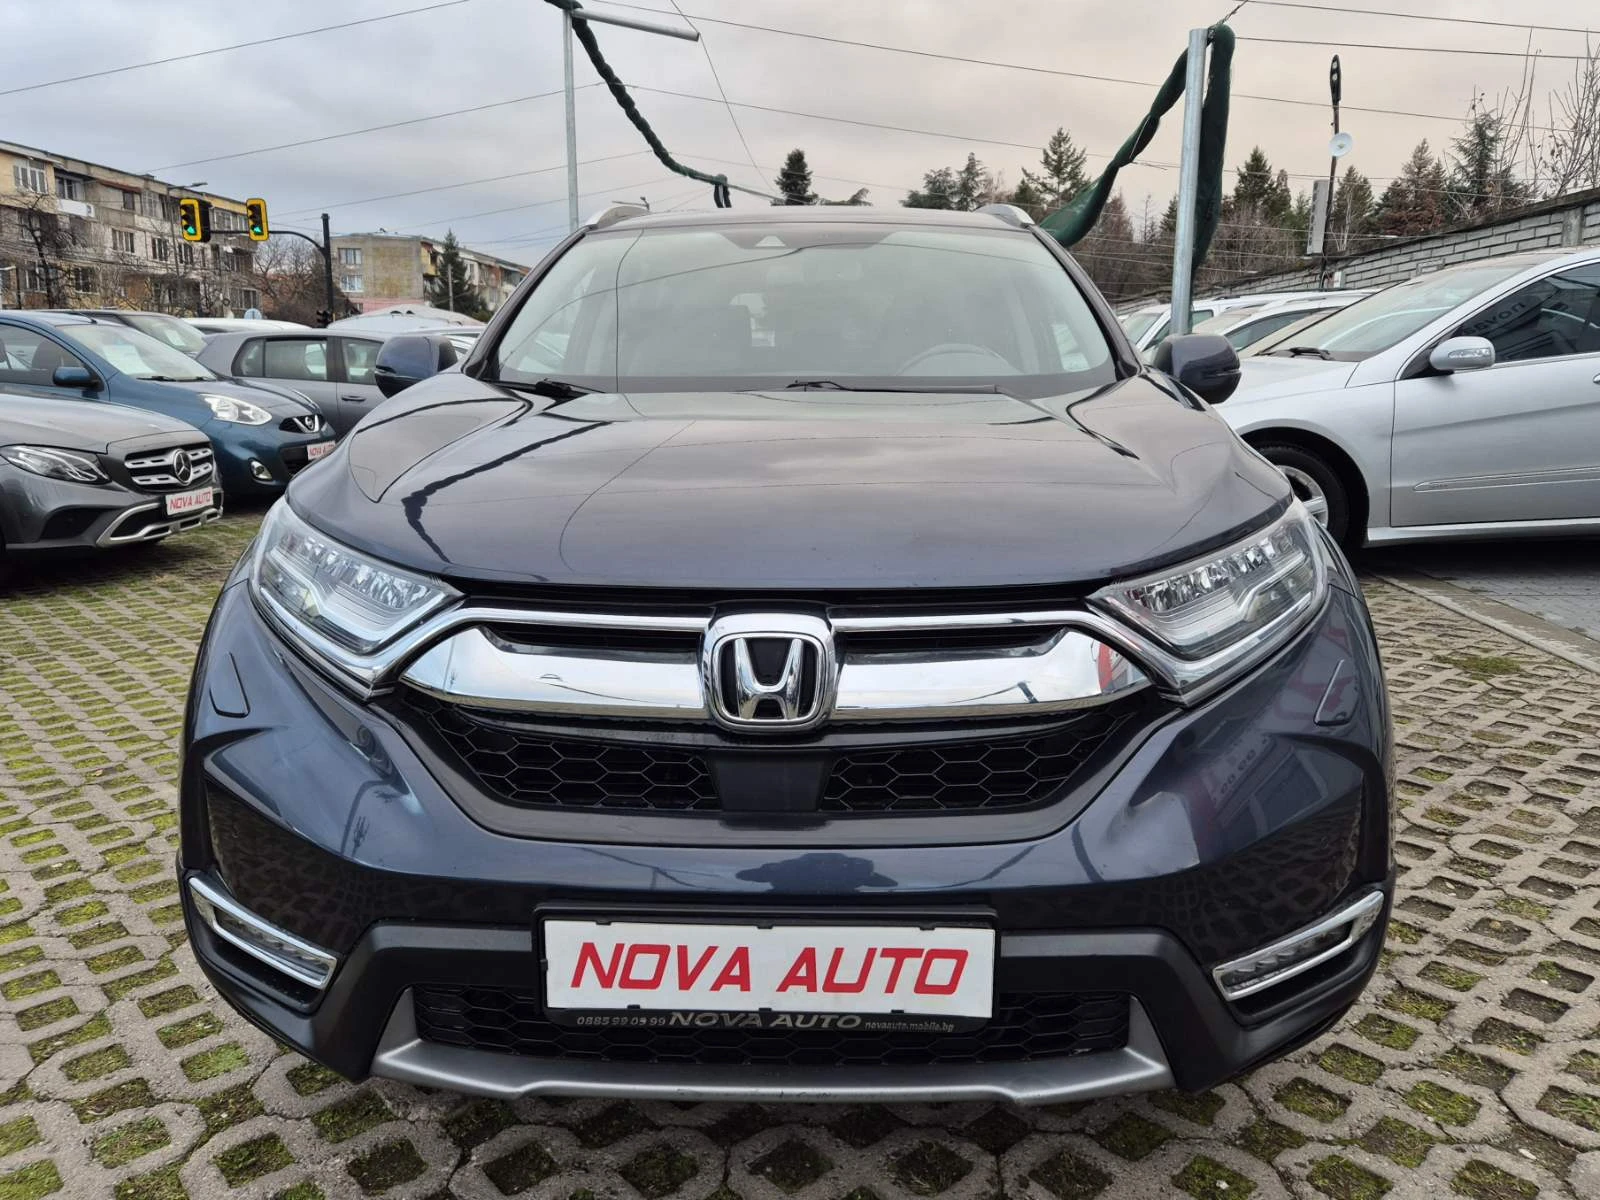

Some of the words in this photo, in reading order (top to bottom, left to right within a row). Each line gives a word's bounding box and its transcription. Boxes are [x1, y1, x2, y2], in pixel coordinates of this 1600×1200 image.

[170, 496, 192, 509] NOVA
[194, 491, 211, 505] AUTO
[570, 942, 751, 993] NOVA
[776, 947, 969, 996] AUTO
[576, 1015, 610, 1025] 0885
[669, 1011, 762, 1027] NOVA
[769, 1014, 862, 1029] AUTO
